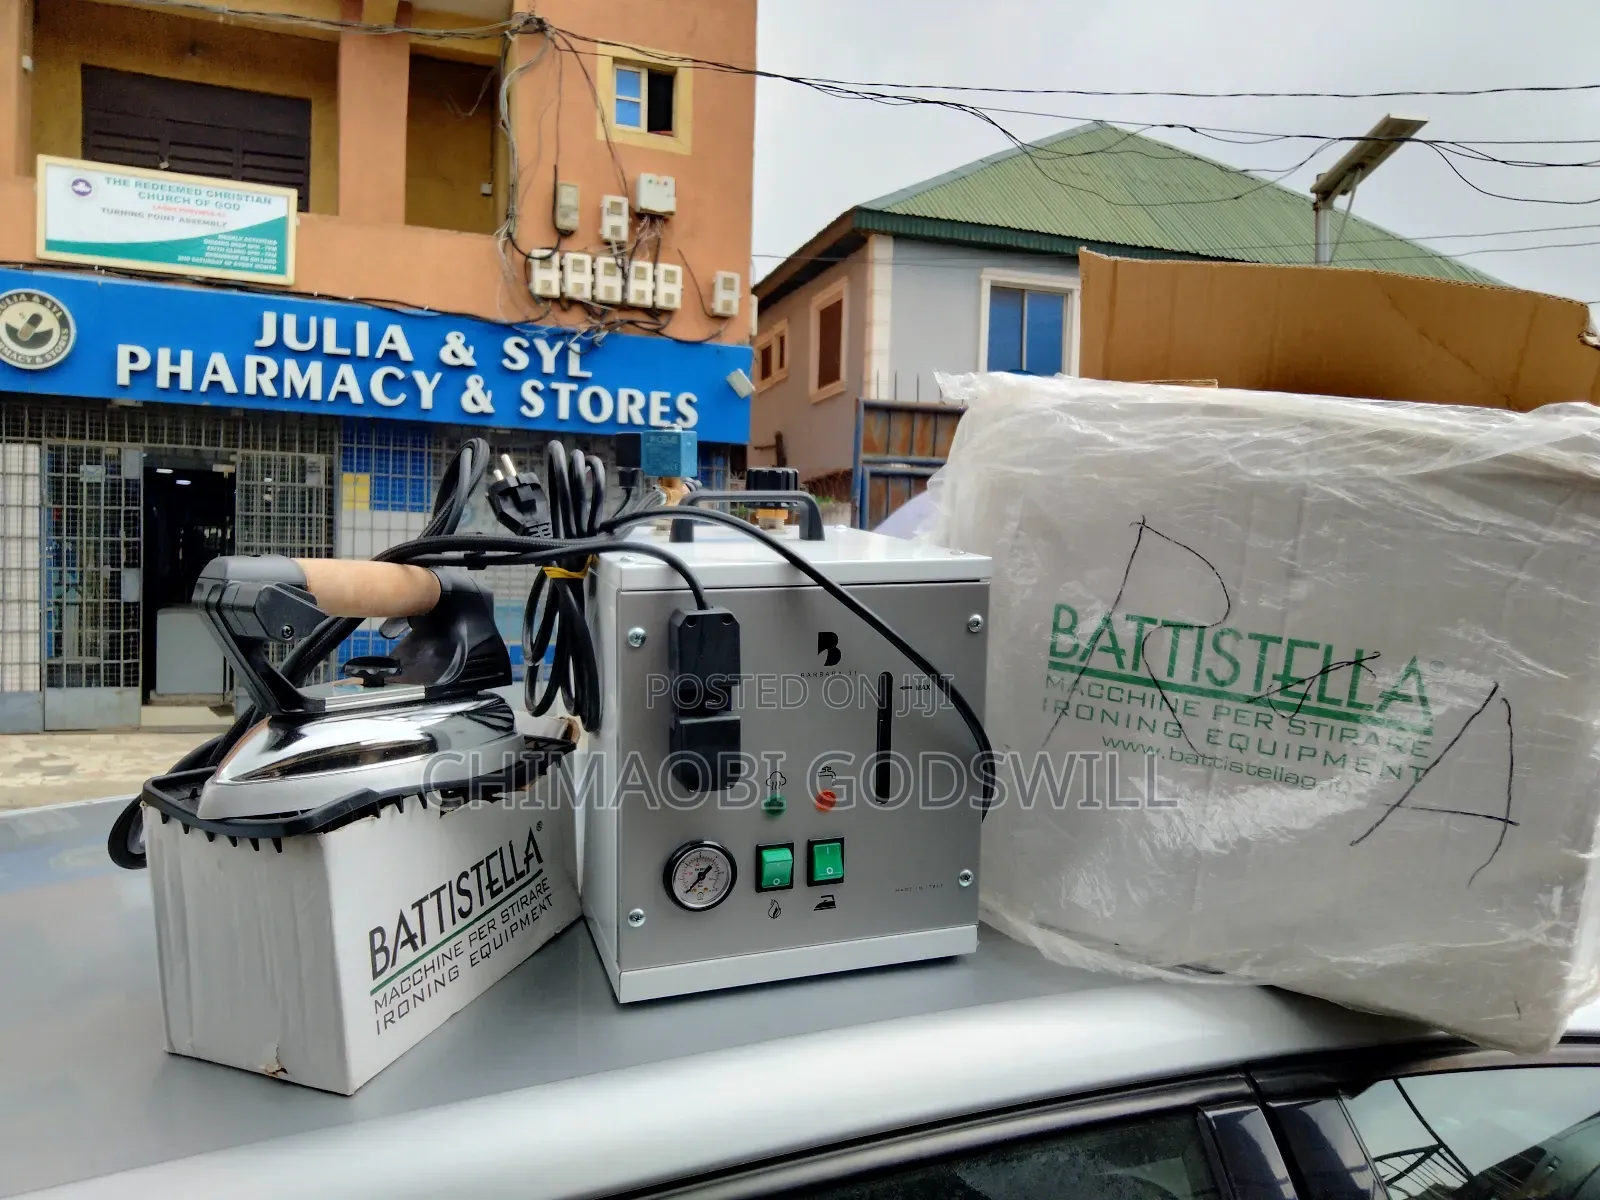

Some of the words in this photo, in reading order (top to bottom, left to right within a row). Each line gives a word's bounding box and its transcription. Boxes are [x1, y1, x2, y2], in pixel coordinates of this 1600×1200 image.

[100, 207, 145, 219] TURNING
[148, 212, 175, 222] POINT
[179, 216, 228, 228] ASSEMBLY
[104, 176, 131, 188] THE
[134, 181, 202, 196] REDEEMED
[206, 189, 272, 205] CHRISTIAN
[138, 191, 191, 205] CHURCH
[195, 198, 210, 207] OF
[214, 201, 241, 211] GOD
[0, 293, 28, 315] ULIA
[254, 310, 414, 362] JULIA
[438, 331, 477, 367] &
[501, 336, 593, 378] SYL
[116, 343, 442, 410] PHARMACY
[460, 374, 495, 413] &
[519, 379, 699, 429] STORES
[1048, 603, 1434, 722] BATTISTELLA
[1043, 697, 1182, 739] IRONING
[1206, 728, 1428, 784] EQUIPMENT
[1045, 675, 1201, 718] MACCHINE
[1213, 704, 1273, 730] PER
[368, 826, 544, 981] BATTISTELLA
[374, 940, 464, 1015] MACCHINE
[468, 918, 497, 948] PER
[501, 876, 550, 924] STIRARE
[376, 965, 460, 1036] IRONING
[470, 893, 553, 969] EQUIPMENT
